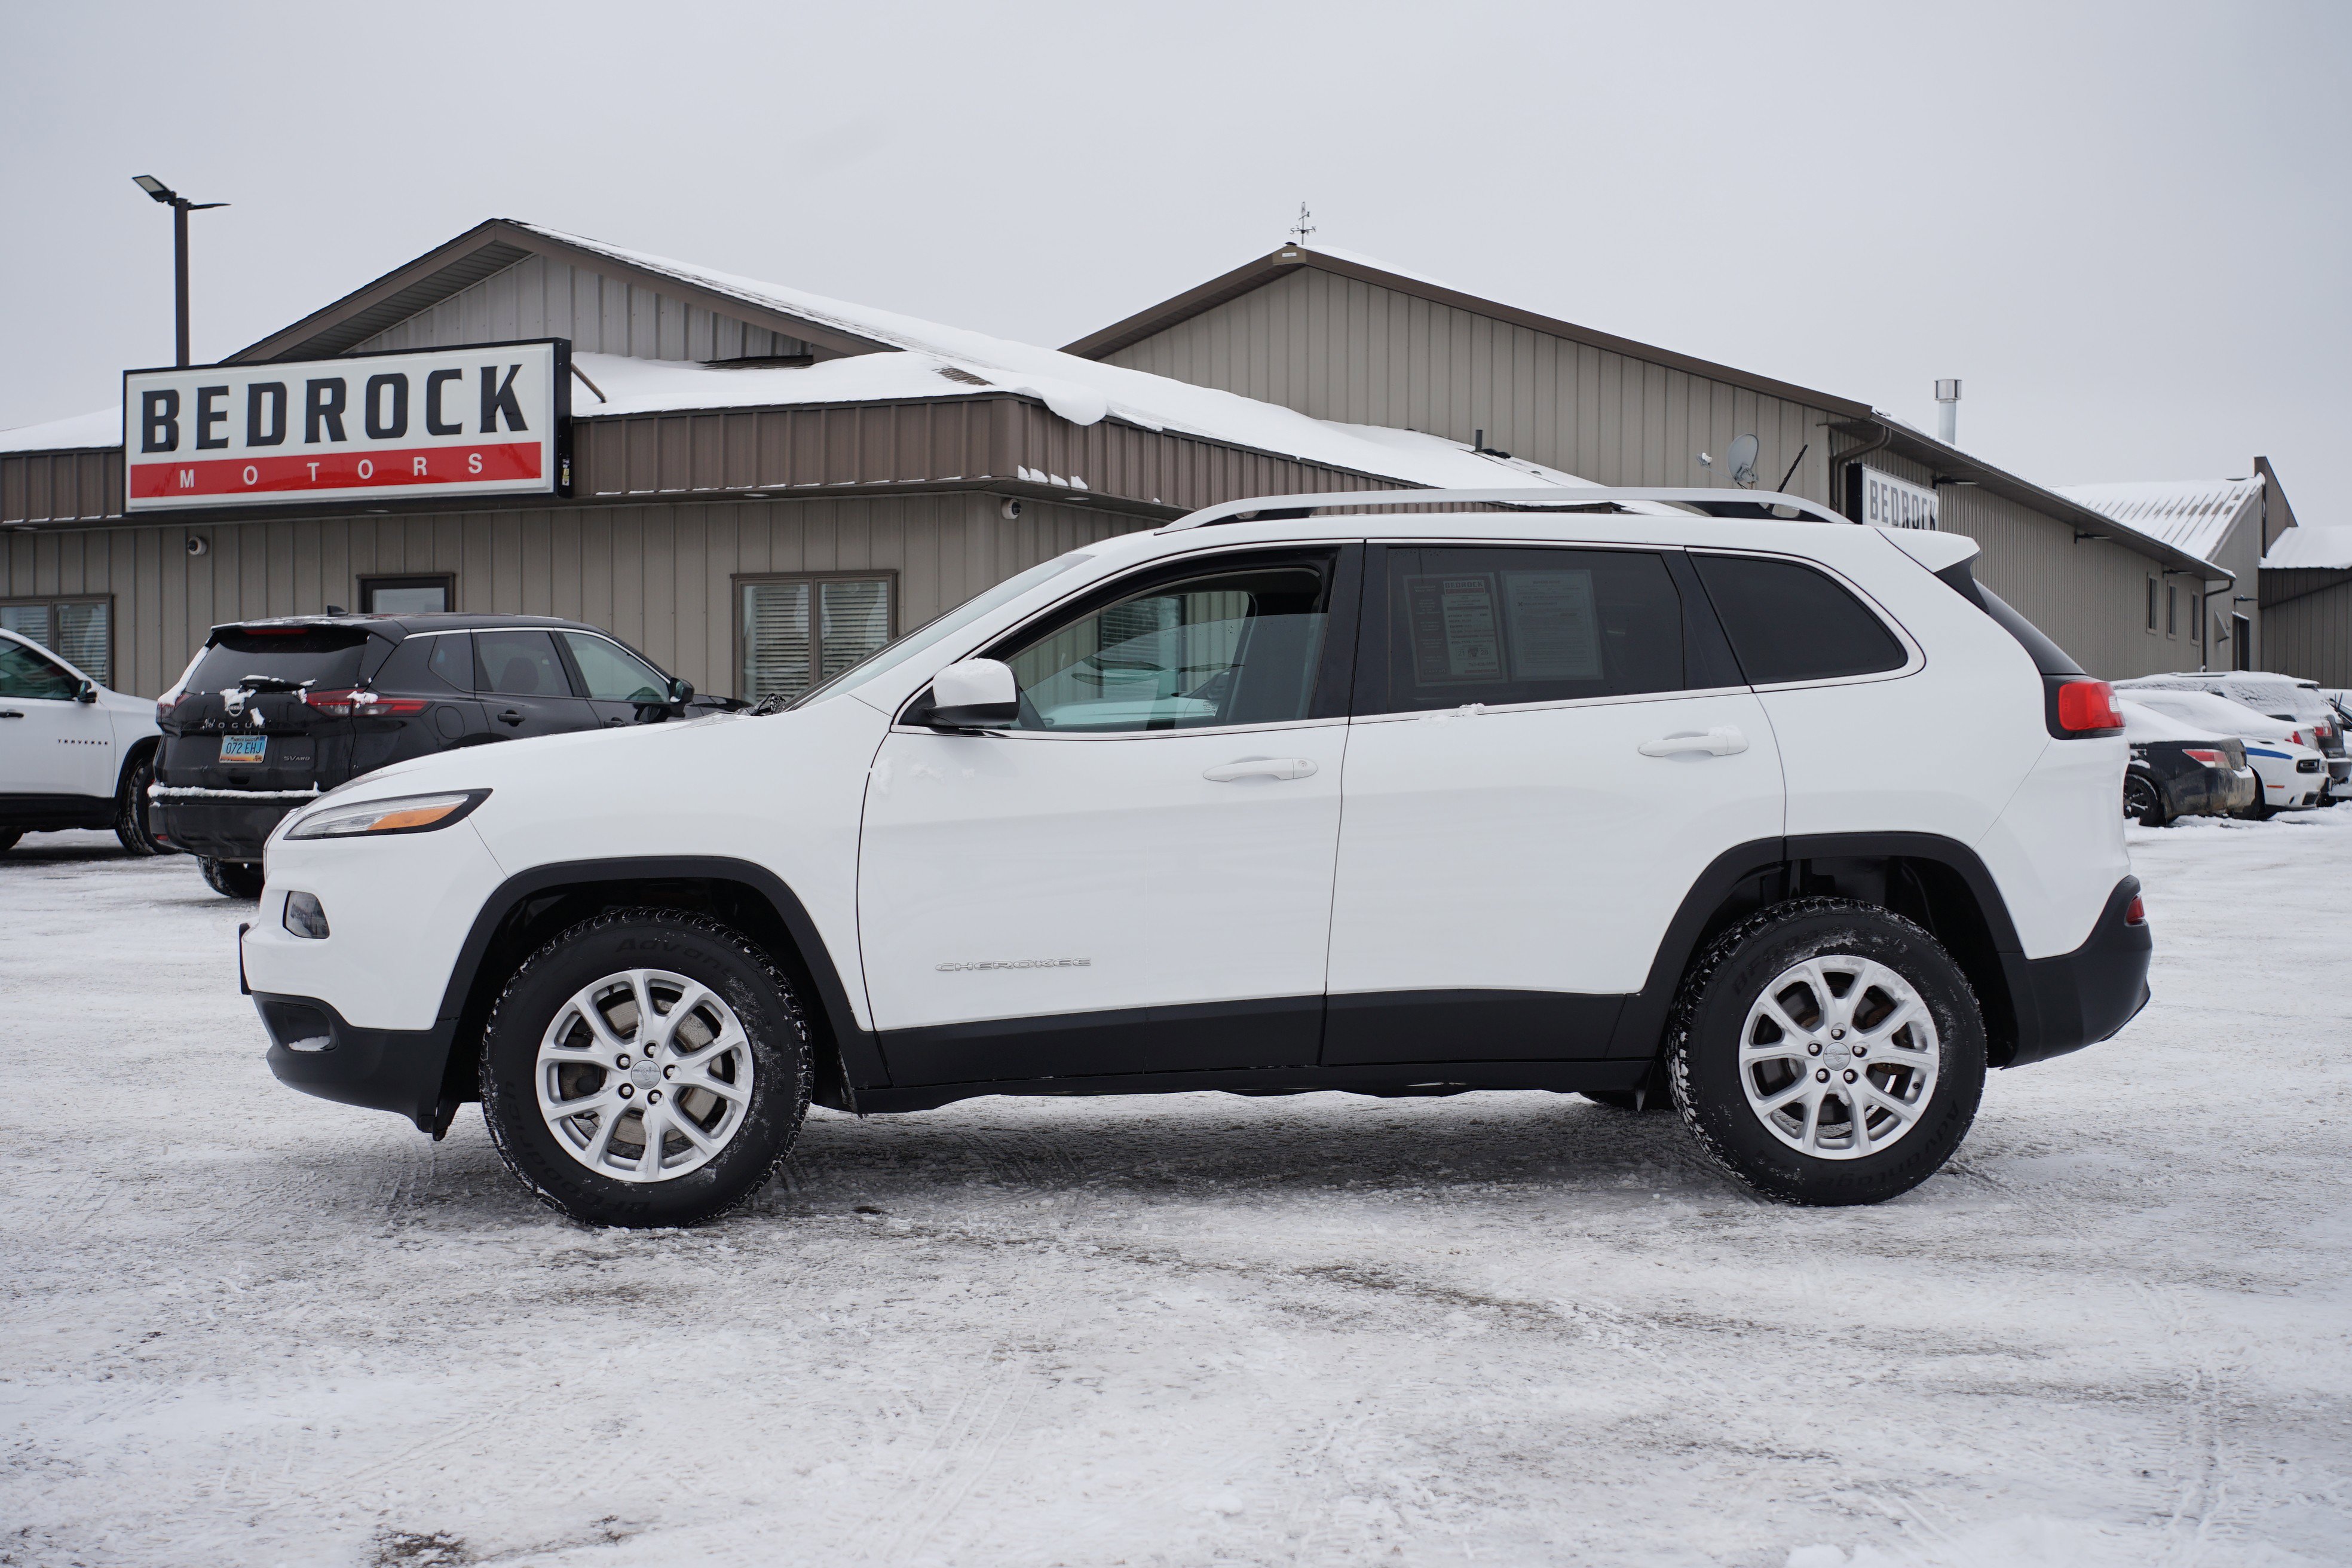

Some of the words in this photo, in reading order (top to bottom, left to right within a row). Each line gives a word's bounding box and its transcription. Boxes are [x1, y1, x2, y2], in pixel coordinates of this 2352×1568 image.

[142, 364, 529, 454] BEDROCK
[179, 452, 483, 489] MOTORS
[1869, 479, 1936, 531] BEDROCK
[226, 742, 243, 754] 072
[244, 742, 262, 754] EHJ
[935, 957, 1091, 972] CHEROKEE
